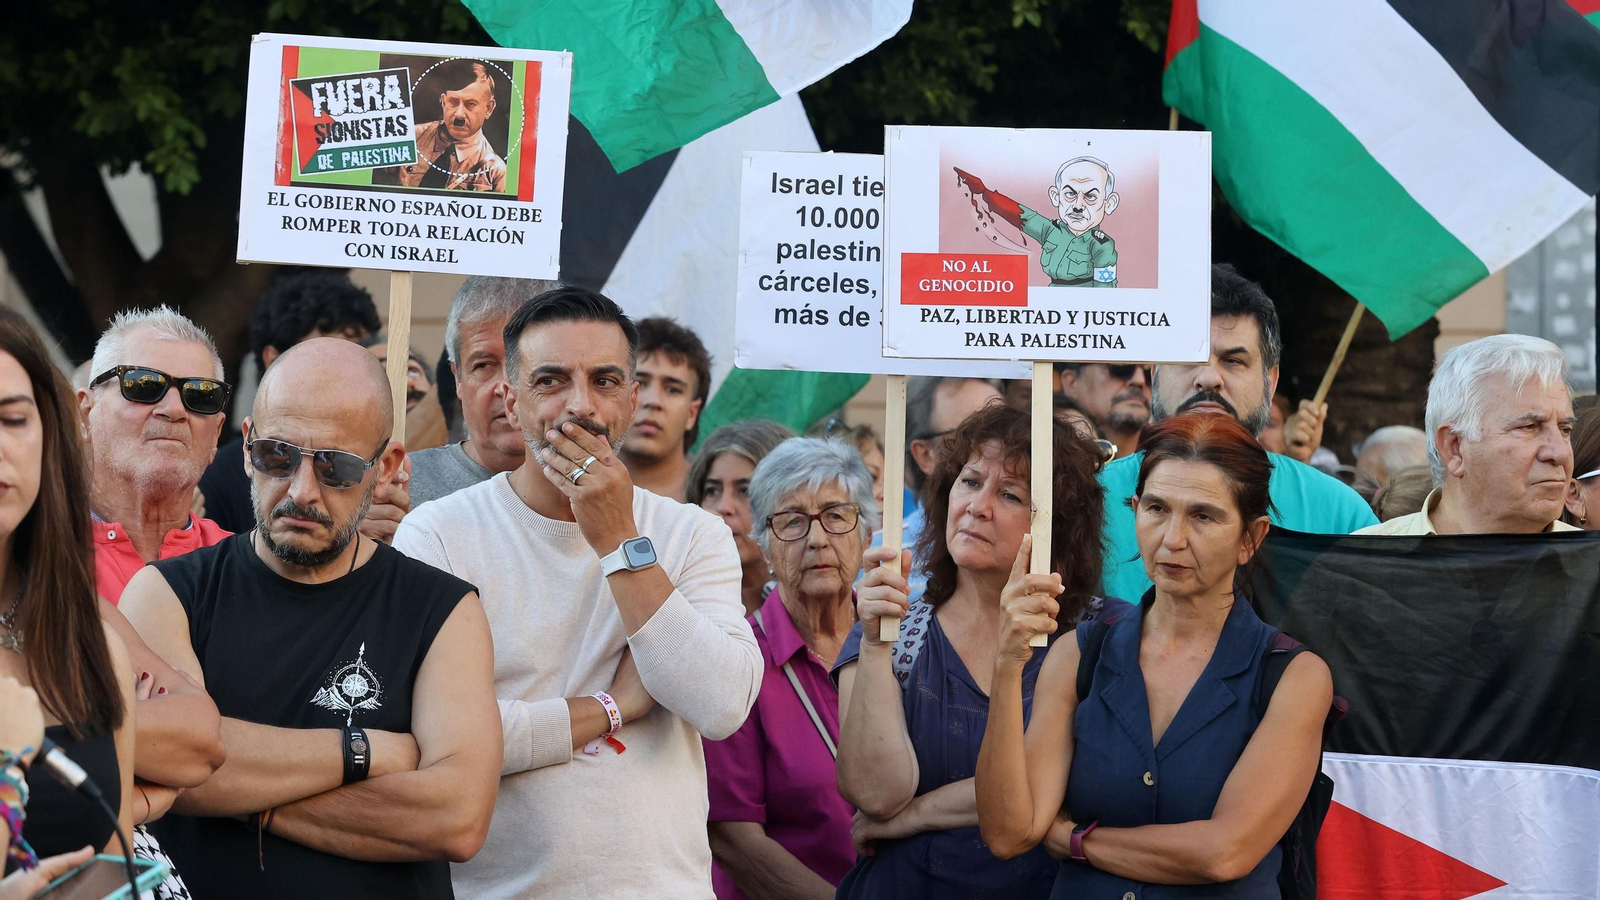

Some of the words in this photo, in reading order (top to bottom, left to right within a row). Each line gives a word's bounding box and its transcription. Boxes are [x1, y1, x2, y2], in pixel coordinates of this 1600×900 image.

[311, 74, 406, 117] FUERA
[314, 115, 408, 144] SIONISTAS
[317, 152, 334, 170] DE
[342, 145, 411, 167] PALESTINA
[771, 172, 844, 196] Israel
[267, 192, 289, 207] EL
[294, 193, 395, 214] GOBIERNO
[401, 199, 486, 220] ESPAÑOL
[492, 206, 543, 223] DEBE
[795, 206, 880, 230] 10.000
[281, 215, 362, 235] ROMPER
[368, 221, 421, 238] TODA
[426, 225, 525, 245] RELACIÓN
[344, 242, 385, 259] CON
[390, 246, 459, 264] ISRAEL
[777, 239, 881, 264] palestin
[942, 260, 967, 274] NO
[971, 260, 992, 274] AL
[758, 270, 877, 298] cárceles,
[919, 278, 1014, 294] GENOCIDIO
[774, 303, 829, 326] más
[838, 306, 871, 328] de
[920, 307, 961, 326] PAZ,
[965, 309, 1060, 326] LIBERTAD
[1067, 310, 1078, 326] Y
[1083, 310, 1171, 328] JUSTICIA
[964, 331, 1015, 348] PARA
[1020, 333, 1126, 349] PALESTINA
